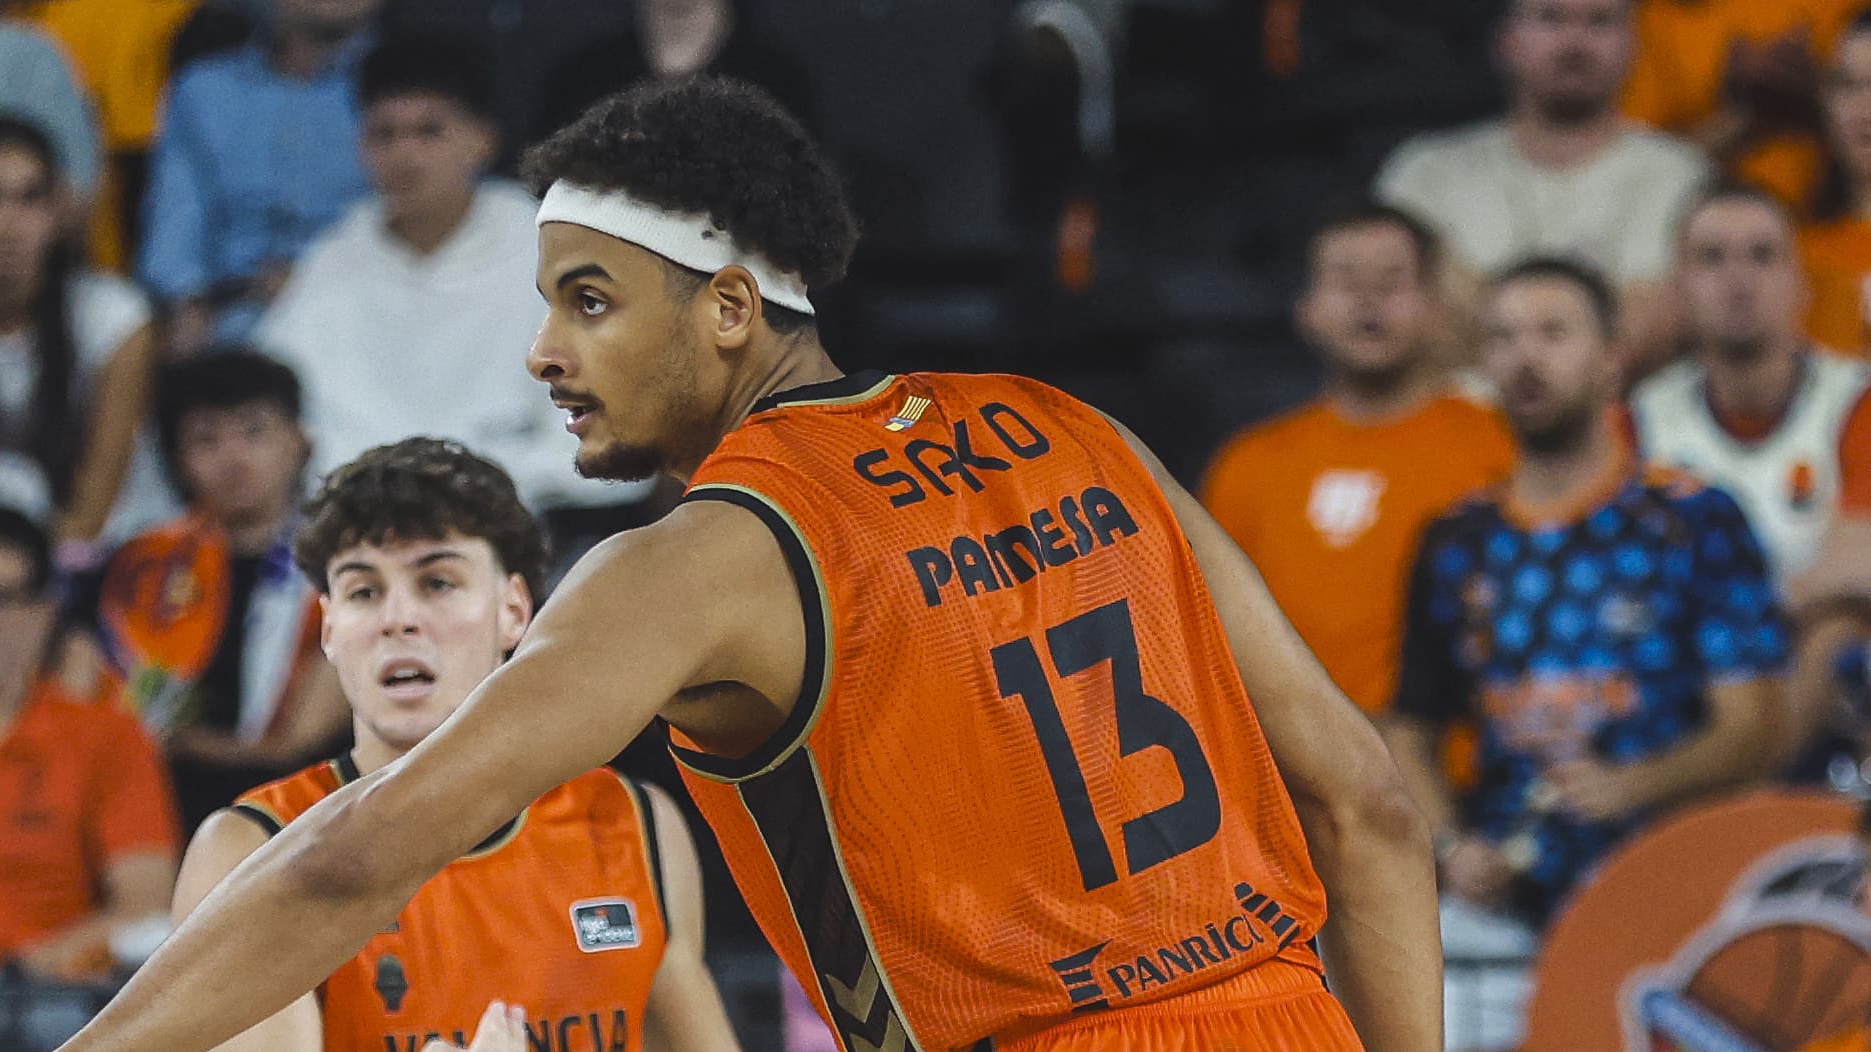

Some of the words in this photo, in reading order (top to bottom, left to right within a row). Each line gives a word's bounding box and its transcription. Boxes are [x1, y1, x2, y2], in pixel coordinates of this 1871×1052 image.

[852, 402, 1051, 509] SAKO
[906, 486, 1139, 608] PAMESA
[990, 597, 1222, 893] 13
